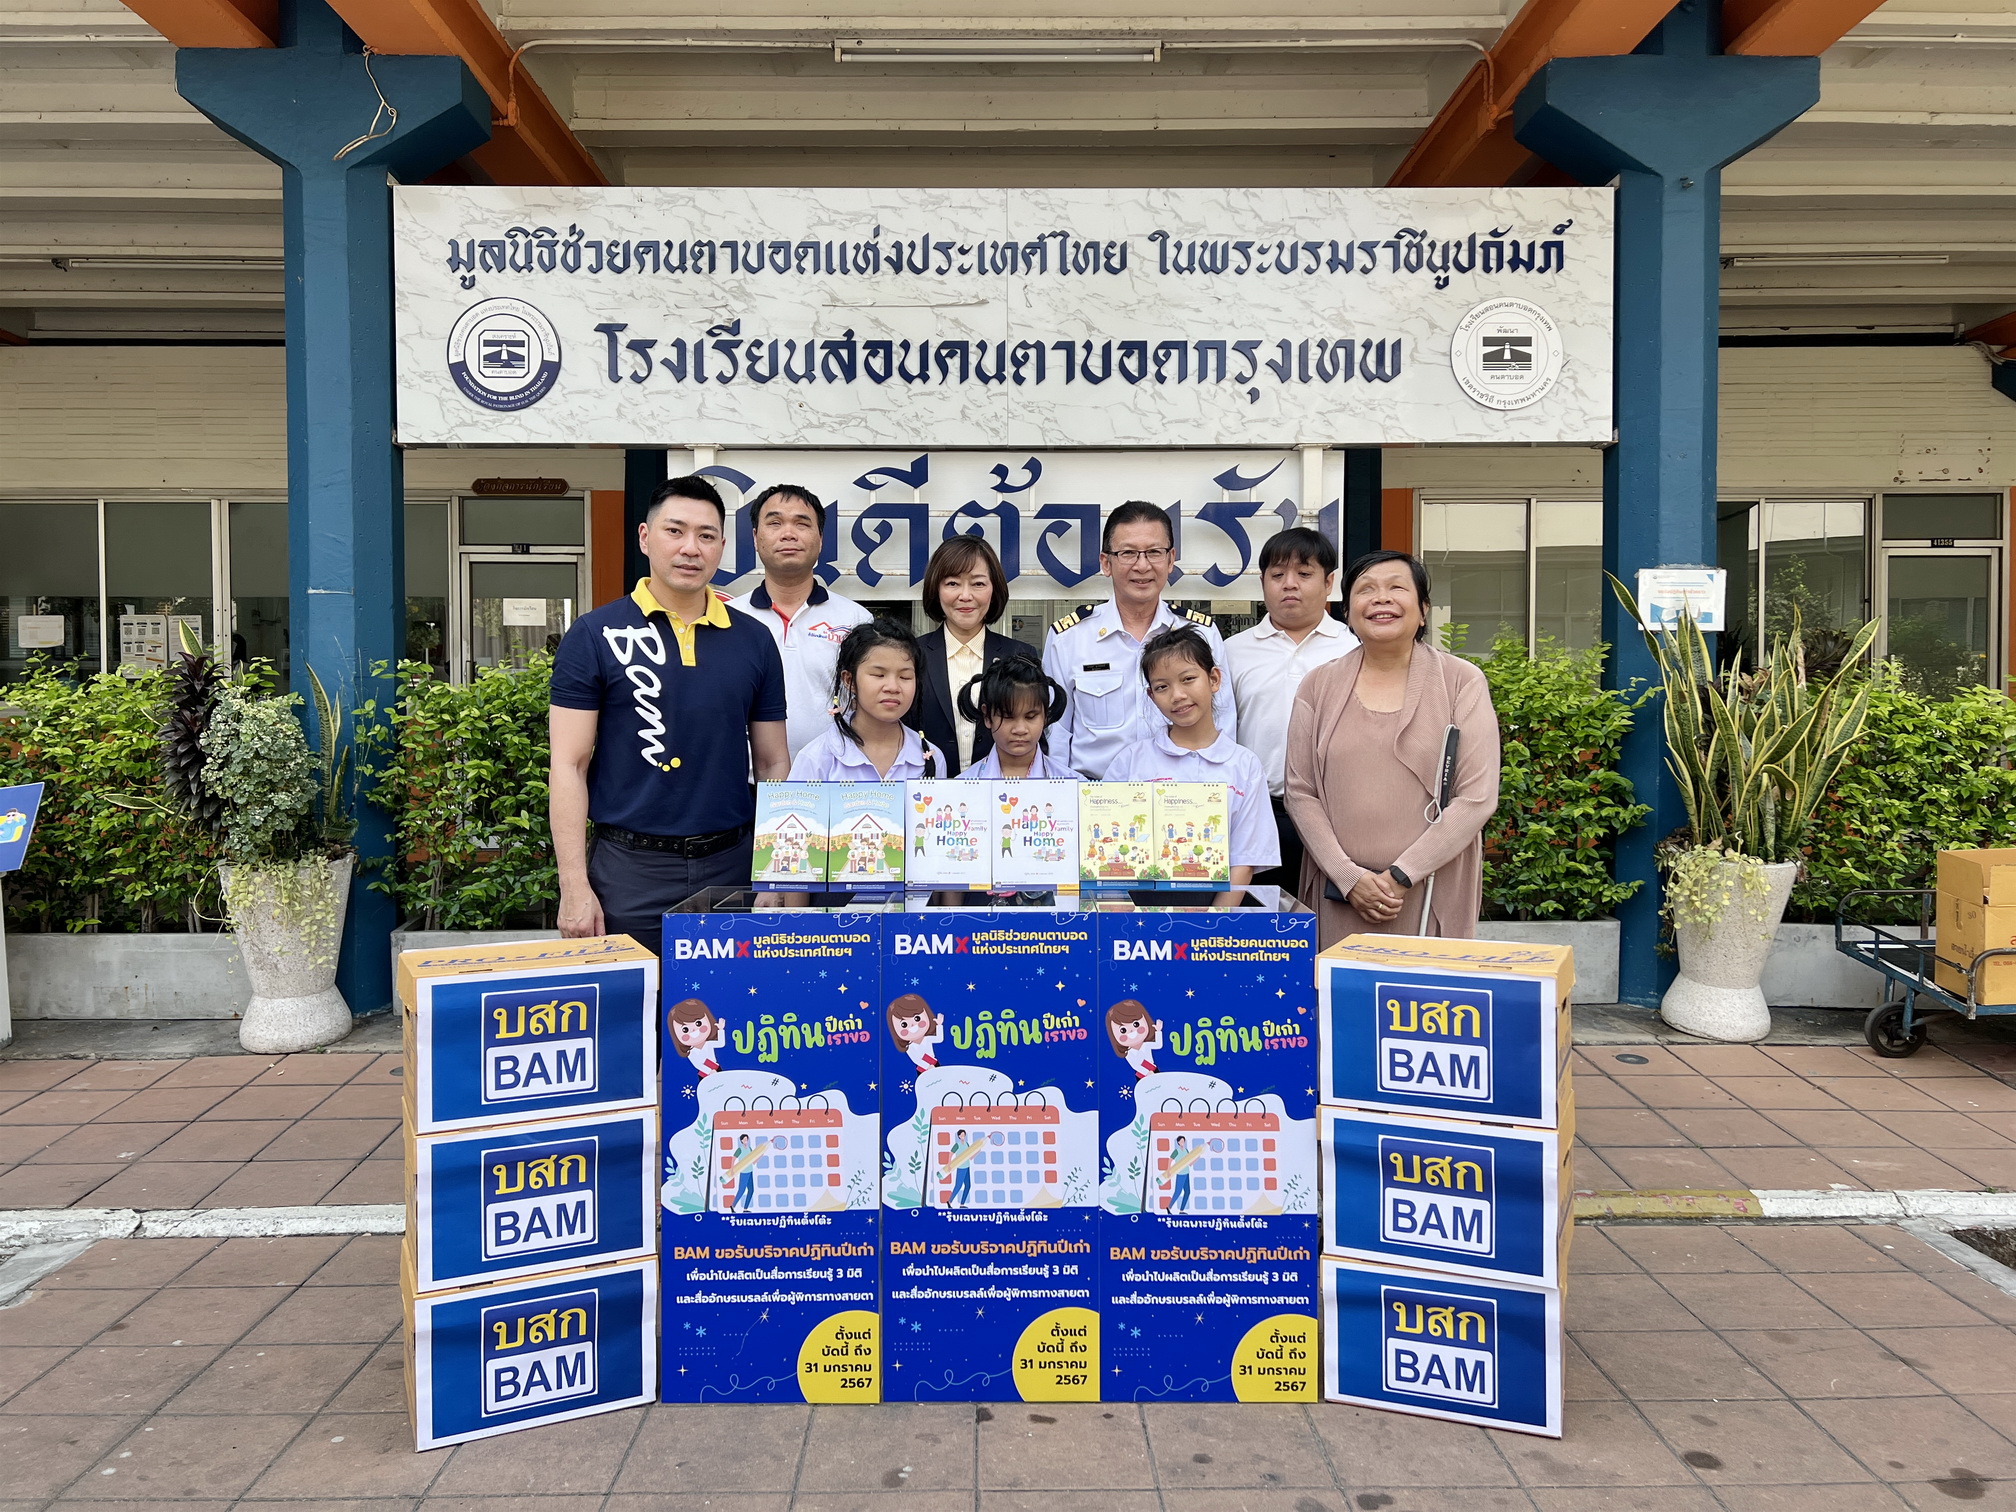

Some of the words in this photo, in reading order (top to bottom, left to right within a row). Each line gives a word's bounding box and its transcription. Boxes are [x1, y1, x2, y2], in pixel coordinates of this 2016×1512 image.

[446, 222, 1129, 289] มูลนิธิช่วยคนตาบอดแห่งประเทศไทย
[1148, 219, 1575, 290] ในพระบรมราชินูปถัมภ์
[1459, 302, 1554, 332] โรงเรียนสอนคนตาบอดกรุงเทพ
[594, 319, 1402, 404] โรงเรียนสอนคนตาบอดกรุงเทพ
[925, 818, 971, 831] Happy
[1011, 818, 1057, 832] Happy
[936, 835, 978, 846] Home
[1023, 836, 1065, 847] Home
[753, 932, 871, 946] มูลนิธิช่วยคนตาบอด
[972, 929, 1088, 942] มูลนิธิช่วยคนตาบอด
[1191, 936, 1308, 951] มูลนิธิช่วยคนตาบอด
[675, 938, 734, 960] BAM
[753, 946, 853, 959] แห่งประเทศไทยฯ
[895, 934, 953, 955] BAM
[972, 943, 1070, 954] แห่งประเทศไทยฯ
[1113, 939, 1172, 960] BAM
[1191, 950, 1290, 962] แห่งประเทศไทยฯ
[493, 1000, 588, 1040] บสก
[825, 1013, 863, 1033] ปีเก่า
[1042, 1011, 1080, 1030] ปีเก่า
[1386, 999, 1481, 1039] บสก
[951, 1009, 1042, 1058] ปฏิทิน
[1044, 1027, 1088, 1042] เราขอ
[1262, 1018, 1300, 1037] ปีเก่า
[732, 1012, 825, 1063] ปฏิทิน
[827, 1029, 871, 1045] เราขอ
[1169, 1016, 1262, 1065] ปฏิทิน
[1264, 1035, 1308, 1049] เราขอ
[494, 1047, 587, 1092] BAM
[1389, 1047, 1481, 1091] BAM
[493, 1154, 587, 1195] บสก
[1389, 1153, 1484, 1193] บสก
[494, 1200, 586, 1247] BAM
[1392, 1198, 1483, 1245] BAM
[674, 1246, 709, 1259] BAM
[715, 1242, 874, 1260] ขอรับบริจาคปฏิทินปีเก่า
[890, 1242, 926, 1255] BAM
[931, 1239, 1091, 1256] ขอรับบริจาคปฏิทินปีเก่า
[1110, 1247, 1145, 1260] BAM
[1151, 1246, 1310, 1263] ขอรับบริจาคปฏิทินปีเก่า
[686, 1267, 833, 1282] เพื่อนำไปผลิตเป็นสื่อการเรียนรู้
[836, 1269, 843, 1278] 3
[847, 1268, 862, 1278] มิติ
[902, 1262, 1049, 1278] เพื่อนำไปผลิตเป็นสื่อการเรียนรู้
[1052, 1266, 1059, 1275] 3
[1063, 1265, 1079, 1275] มิติ
[1122, 1269, 1269, 1285] เพื่อนำไปผลิตเป็นสื่อการเรียนรู้
[1272, 1272, 1279, 1282] 3
[1283, 1271, 1298, 1281] มิติ
[676, 1289, 874, 1305] และสื่ออักษรเบรลล์เพื่อผู้พิการทางสายตา
[892, 1285, 1090, 1301] และสื่ออักษรเบรลล์เพื่อผู้พิการทางสายตา
[1112, 1292, 1309, 1307] และสื่ออักษรเบรลล์เพื่อผู้พิการทางสายตา
[493, 1307, 587, 1350] บสก
[1050, 1322, 1088, 1337] ตั้งแต่
[1392, 1301, 1486, 1344] บสก
[835, 1326, 872, 1340] ตั้งแต่
[1270, 1329, 1307, 1344] ตั้งแต่
[822, 1341, 849, 1356] บัดนี้
[854, 1344, 872, 1356] ถึง
[1037, 1337, 1064, 1353] บัดนี้
[1069, 1341, 1087, 1353] ถึง
[1256, 1346, 1284, 1360] บัดนี้
[1288, 1348, 1306, 1359] ถึง
[805, 1362, 818, 1373] 31
[823, 1363, 872, 1373] มกราคม
[1020, 1358, 1033, 1369] 31
[1038, 1359, 1087, 1369] มกราคม
[1239, 1365, 1252, 1376] 31
[1257, 1366, 1306, 1376] มกราคม
[1394, 1348, 1486, 1395] BAM
[494, 1351, 586, 1404] BAM
[840, 1377, 872, 1388] 2567
[1055, 1375, 1088, 1385] 2567
[1274, 1381, 1307, 1392] 2567
